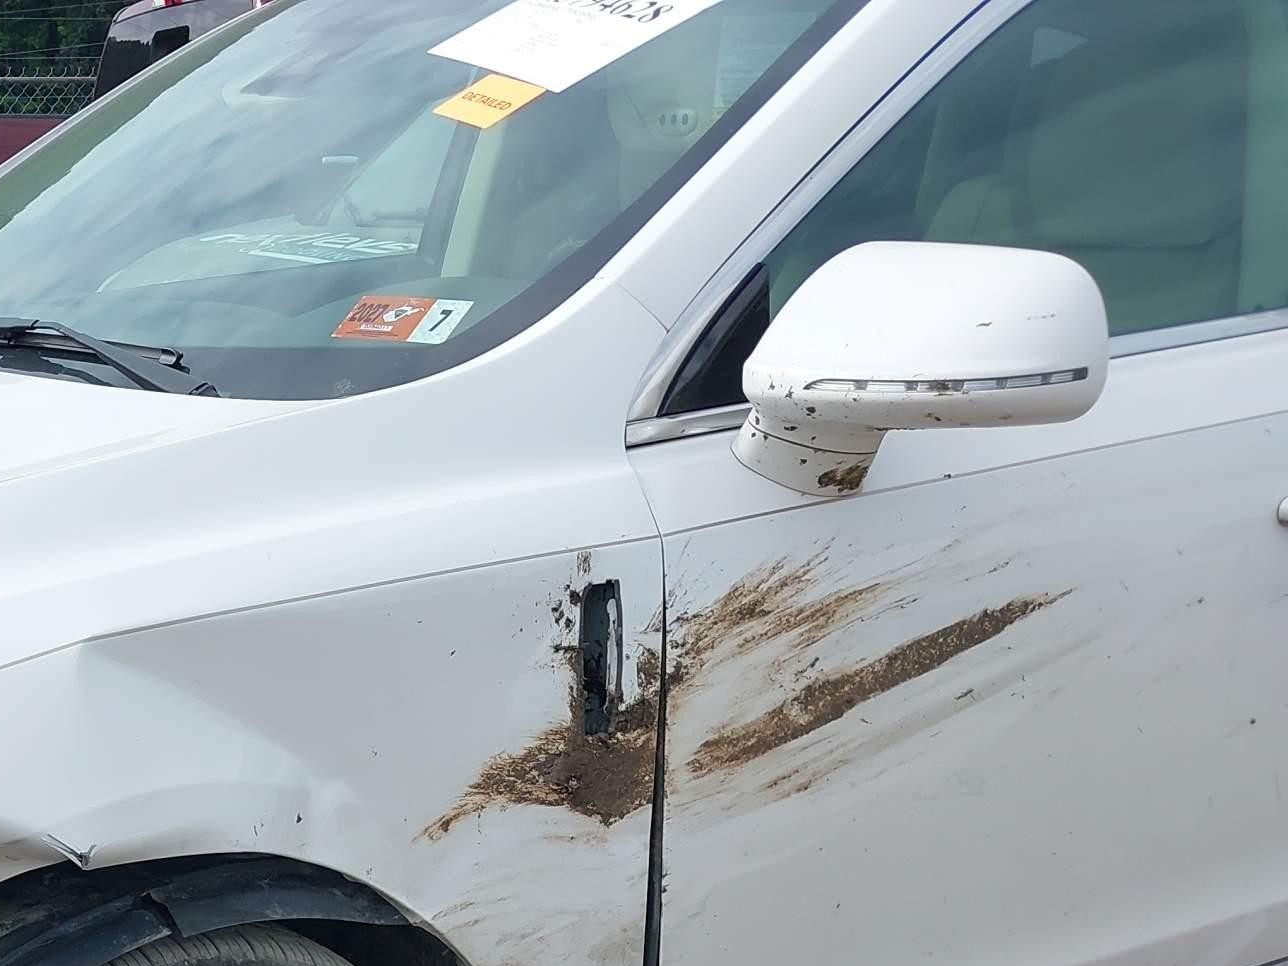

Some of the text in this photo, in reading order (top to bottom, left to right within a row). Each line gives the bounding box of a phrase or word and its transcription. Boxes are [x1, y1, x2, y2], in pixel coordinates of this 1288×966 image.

[462, 91, 513, 111] DETAILED
[349, 302, 391, 323] 2027
[428, 309, 454, 331] 7
